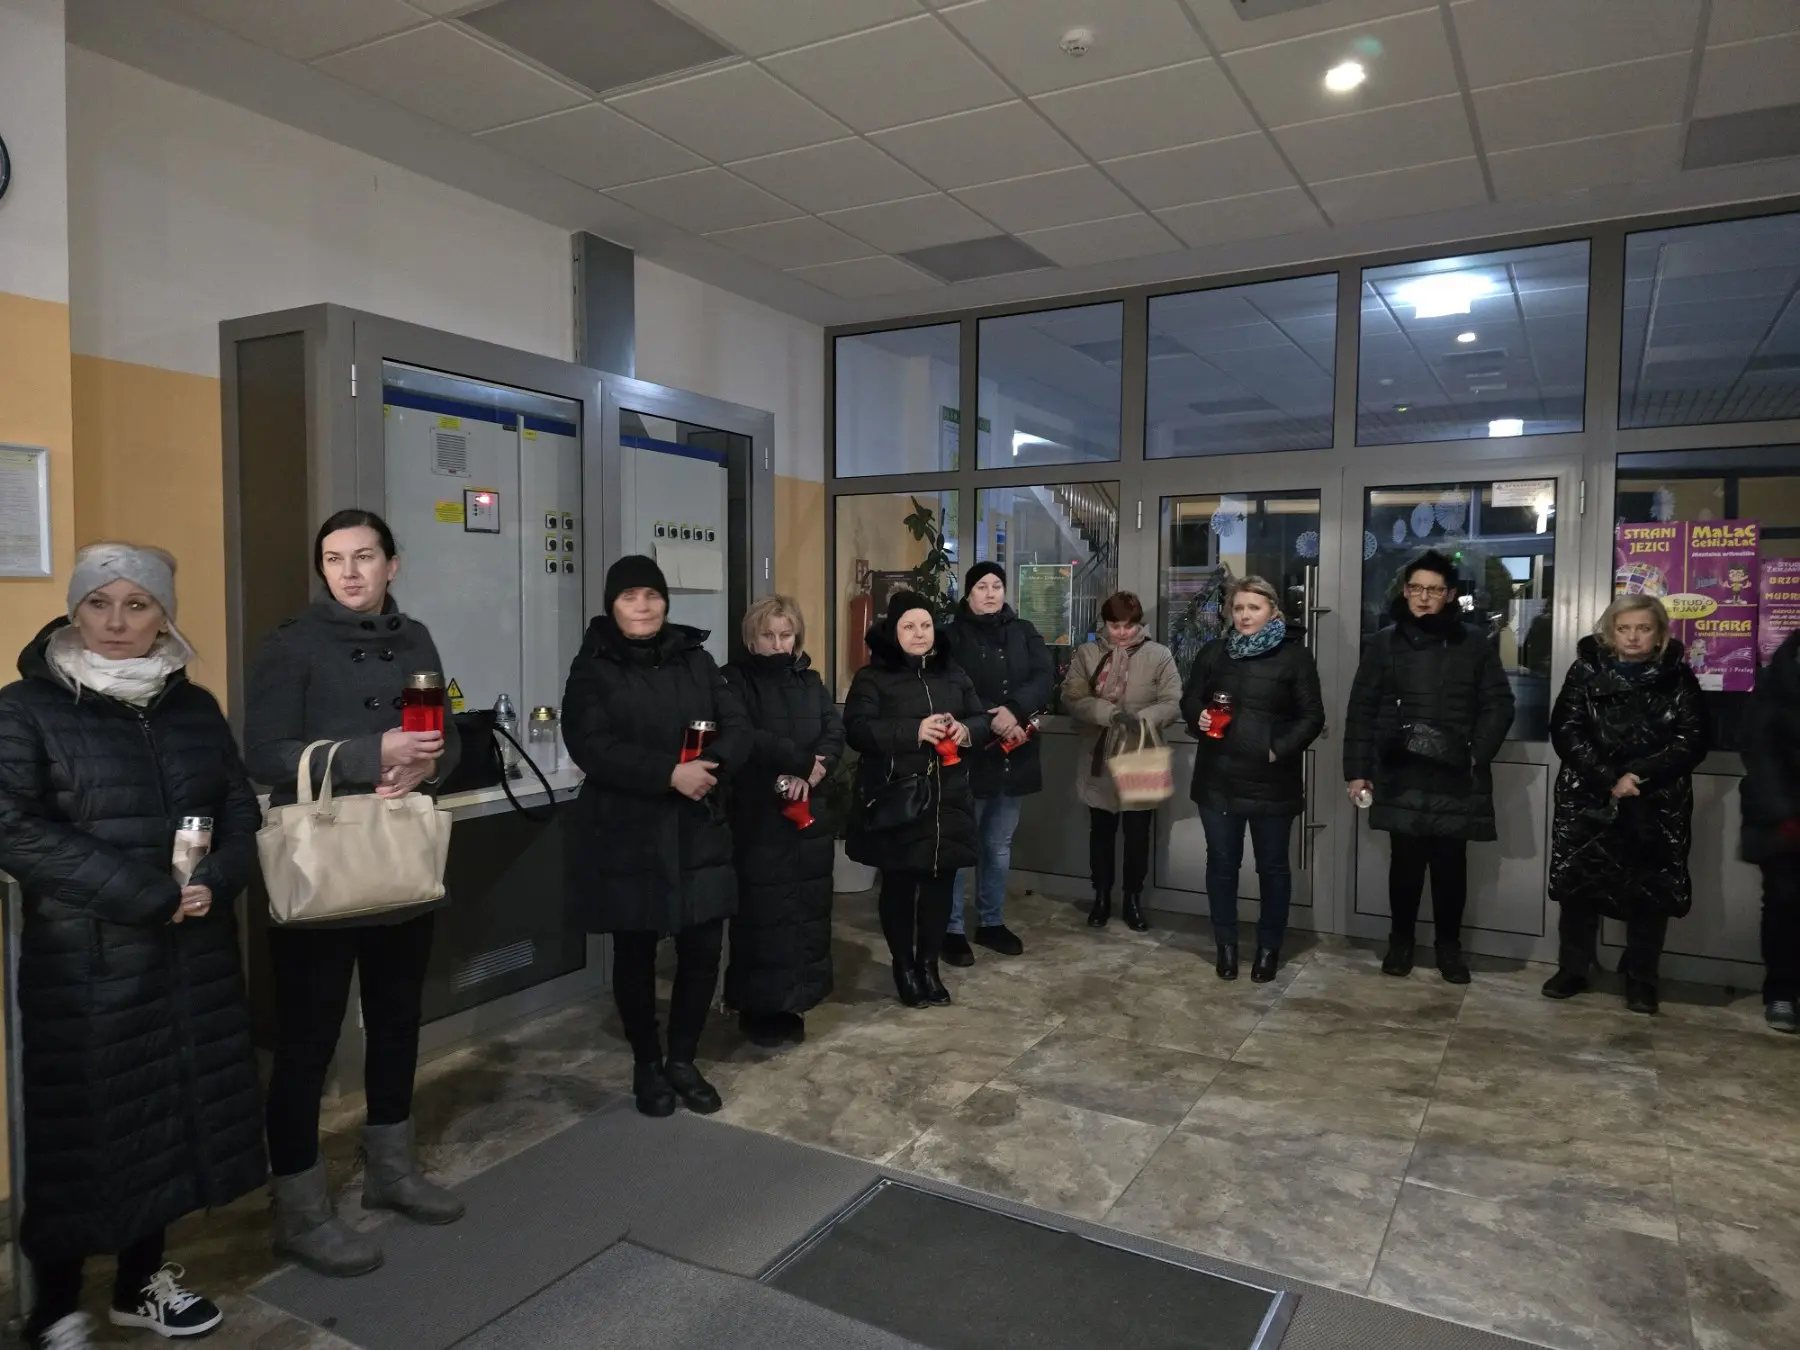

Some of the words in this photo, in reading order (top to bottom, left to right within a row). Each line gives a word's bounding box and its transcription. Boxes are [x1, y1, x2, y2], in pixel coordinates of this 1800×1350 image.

[1624, 528, 1676, 540] STRANI
[1629, 541, 1670, 554] JEZICI
[1695, 620, 1752, 631] GITARA
